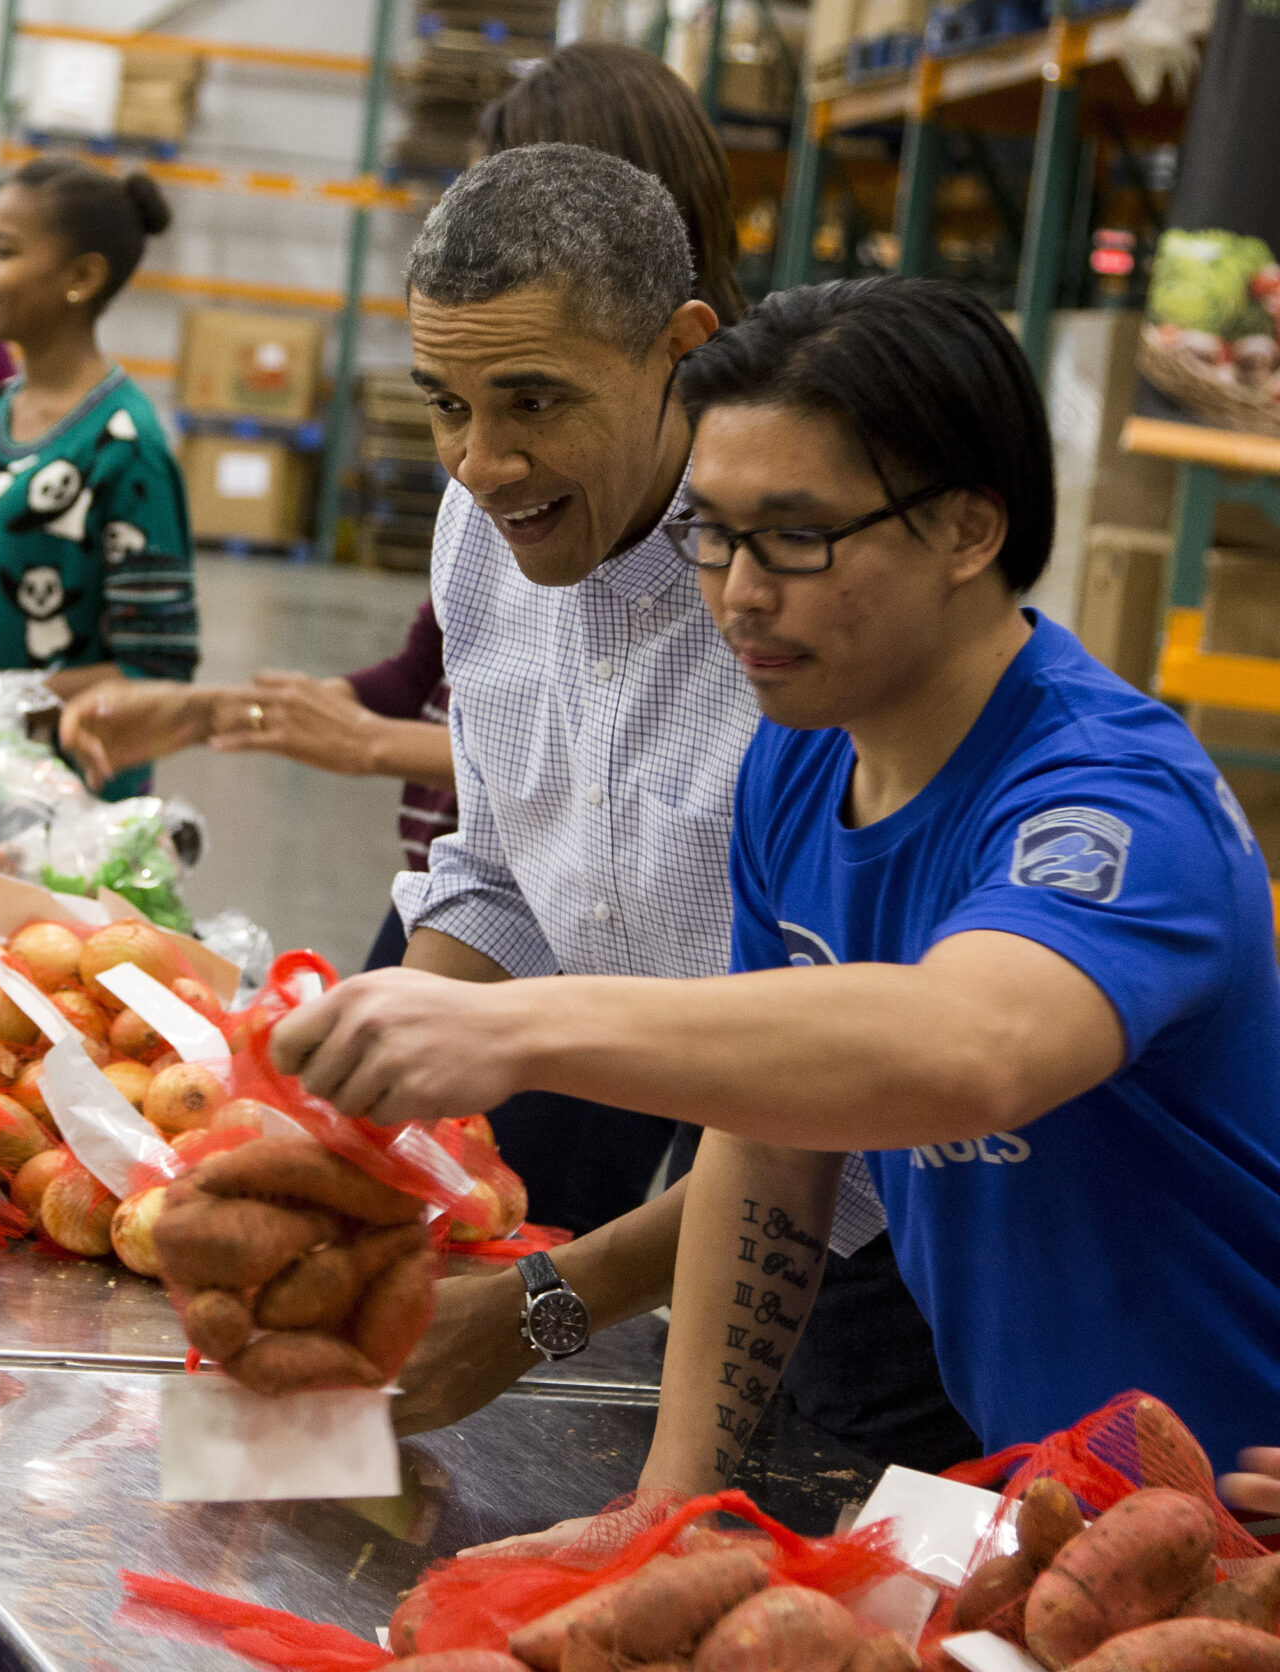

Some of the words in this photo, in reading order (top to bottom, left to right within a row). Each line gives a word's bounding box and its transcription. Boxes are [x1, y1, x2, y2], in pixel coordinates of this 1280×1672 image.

[741, 1198, 760, 1224] I
[738, 1236, 758, 1263] II
[733, 1281, 755, 1309] III
[725, 1324, 750, 1350] IV
[719, 1362, 741, 1388] V
[716, 1402, 737, 1433] VI
